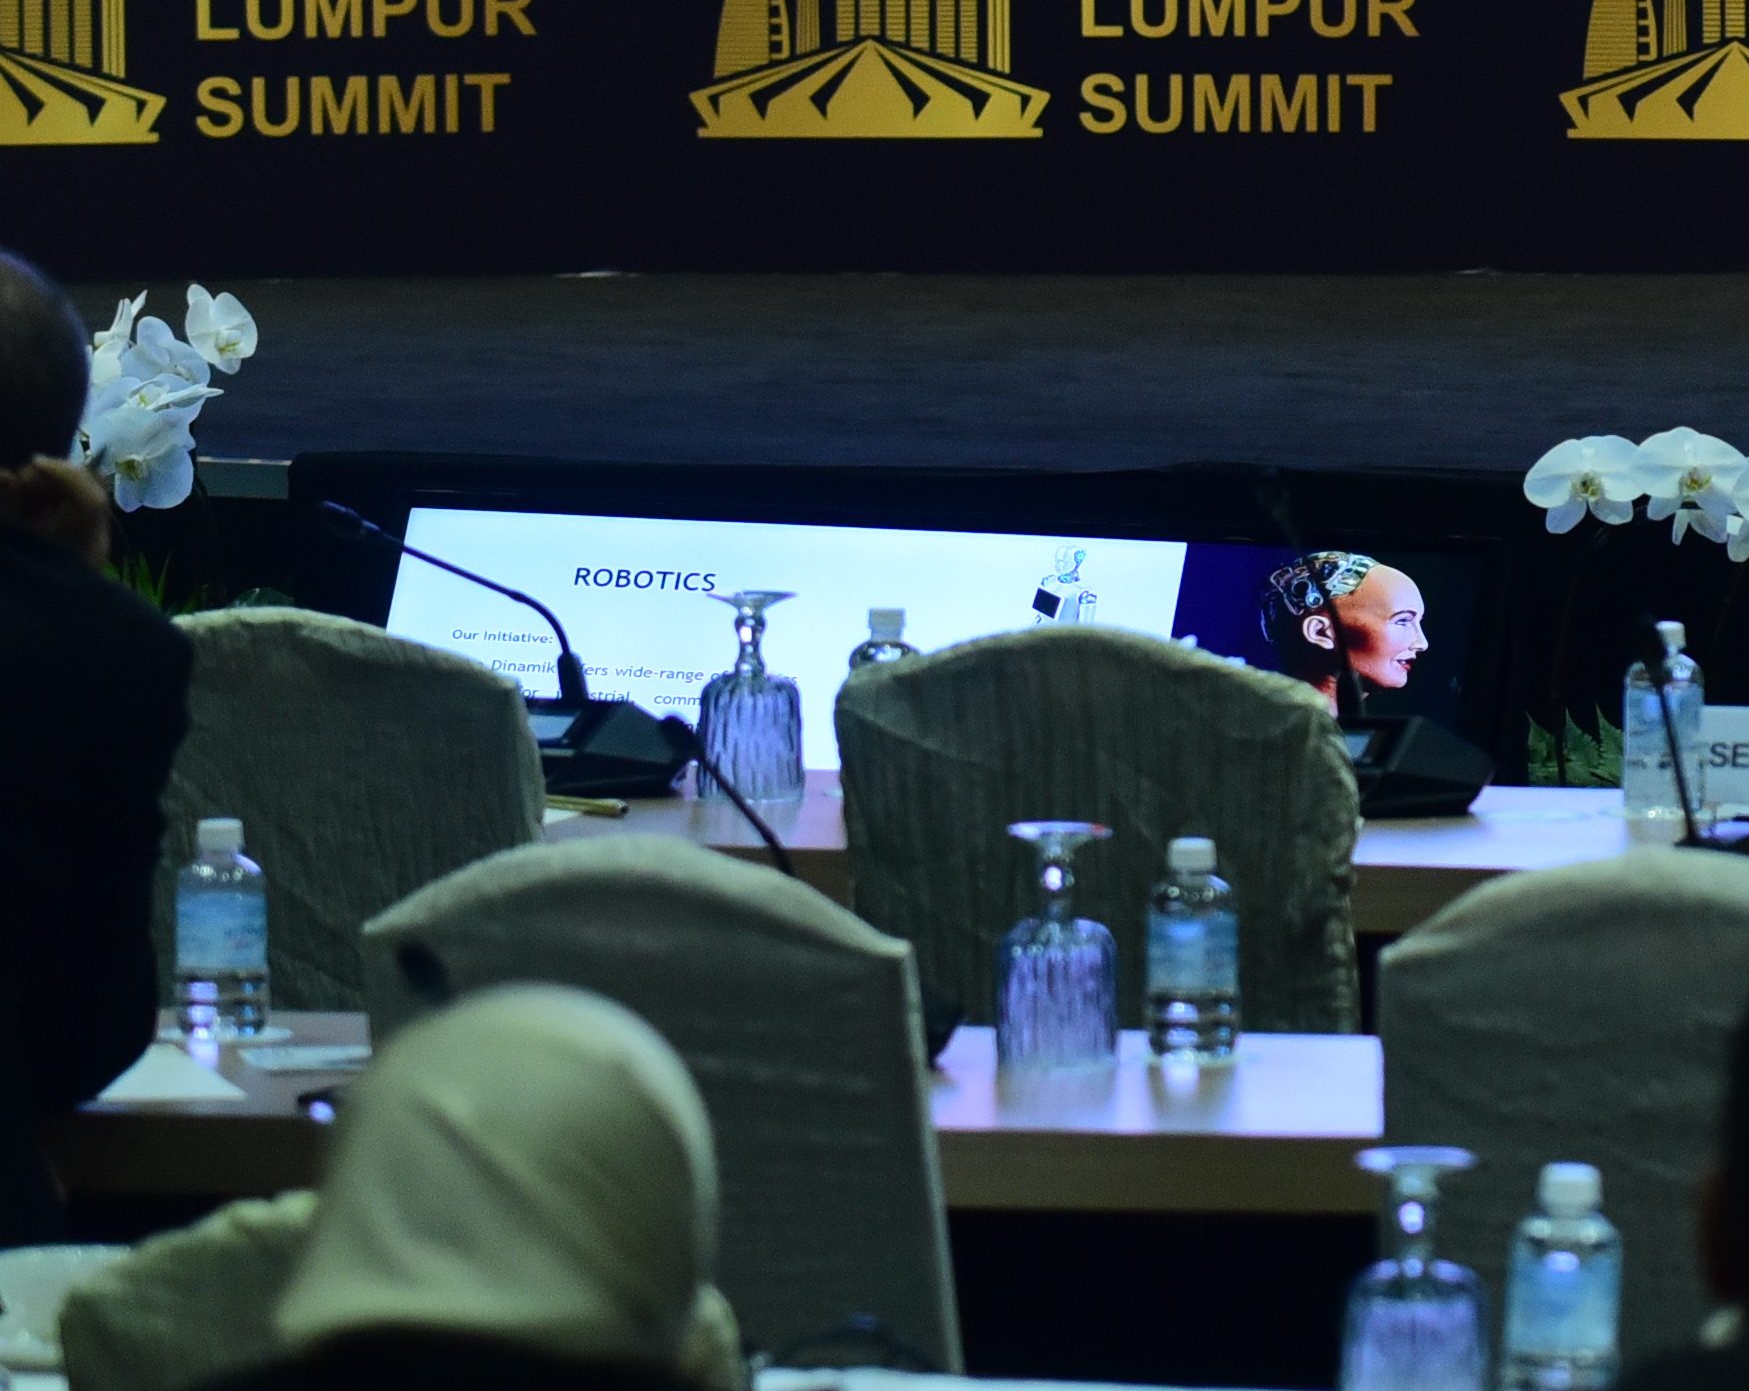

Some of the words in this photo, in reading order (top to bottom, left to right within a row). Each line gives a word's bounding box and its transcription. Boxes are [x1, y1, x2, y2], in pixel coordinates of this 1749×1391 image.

[194, 74, 510, 138] SUMMIT
[1078, 74, 1392, 133] SUMMIT
[574, 567, 716, 592] ROBOTICS
[452, 629, 479, 640] Our
[484, 630, 554, 644] Initiative:
[491, 659, 556, 674] Dinamik
[615, 665, 704, 683] wide-range
